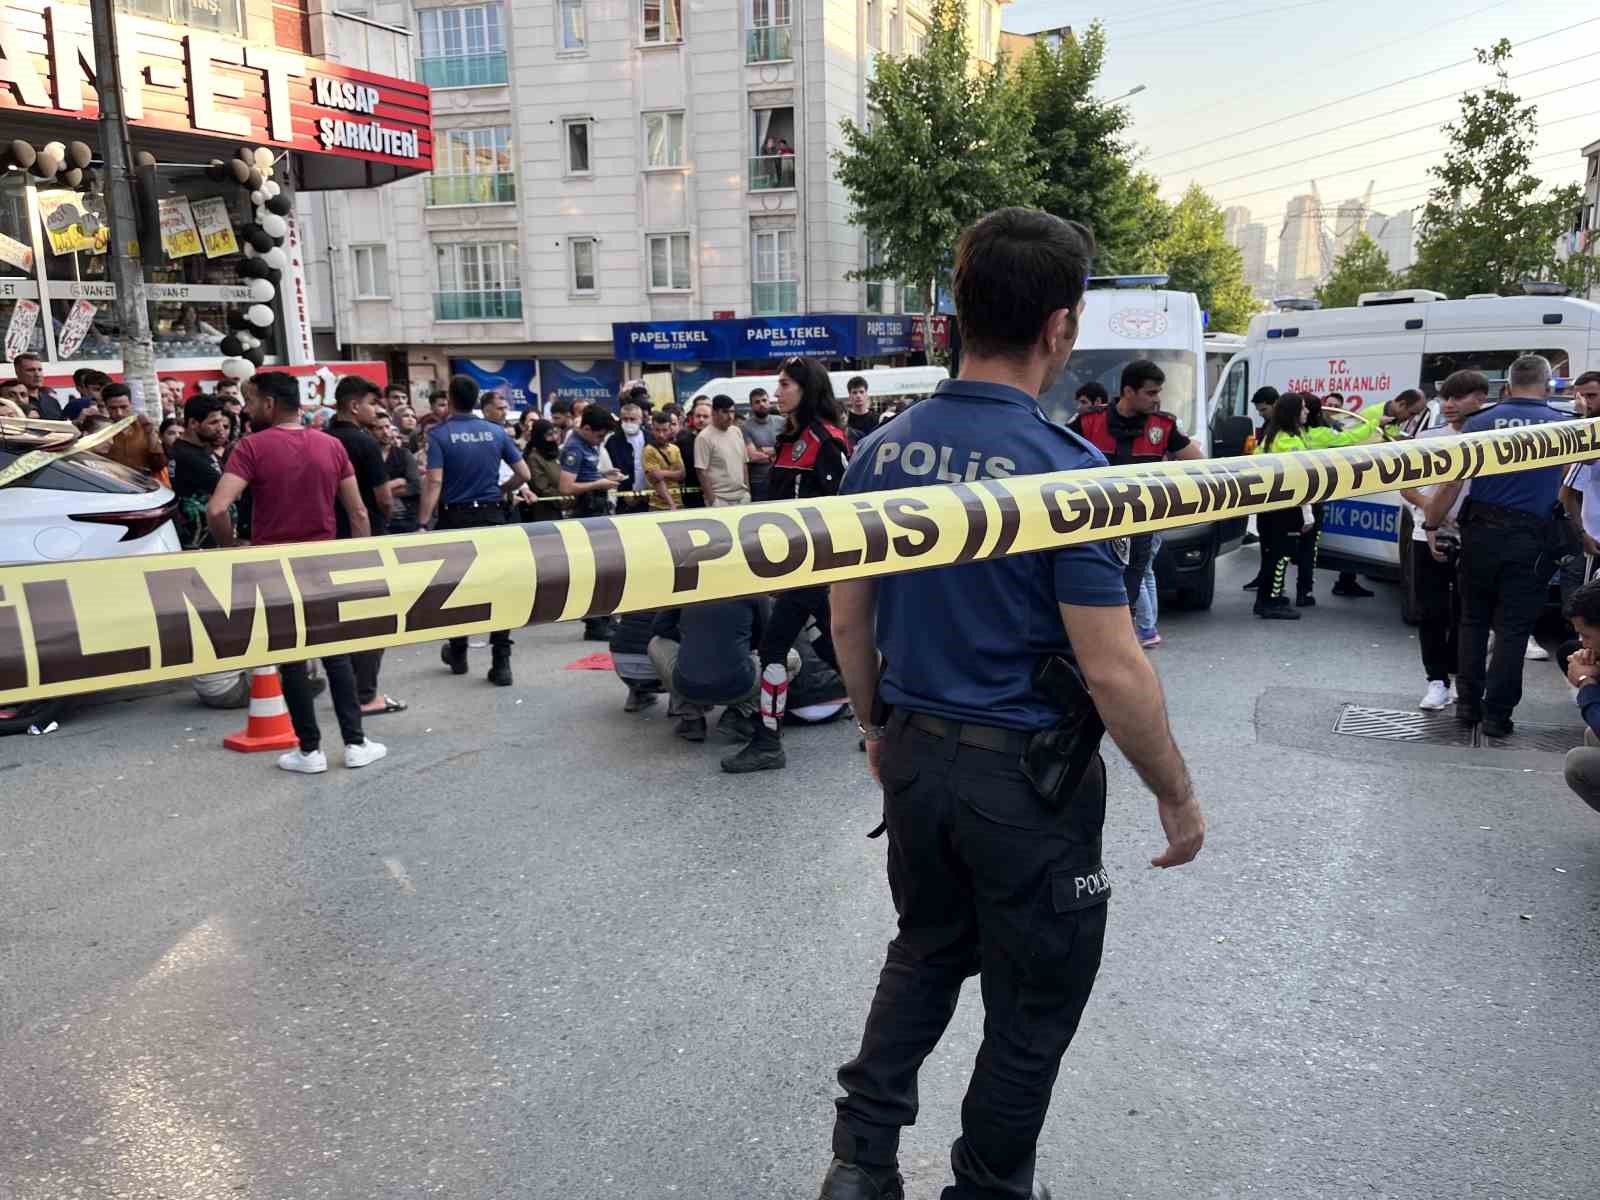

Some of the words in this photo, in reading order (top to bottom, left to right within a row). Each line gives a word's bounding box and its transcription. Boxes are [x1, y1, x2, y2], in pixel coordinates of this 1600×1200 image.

[314, 77, 379, 114] KASAP
[319, 117, 419, 158] ŞARKÜTERİ
[631, 331, 669, 343] PAPEL
[671, 330, 709, 342] TEKEL
[747, 327, 787, 340] PAPEL
[789, 326, 829, 338] TEKEL
[1328, 360, 1350, 375] T.C.
[1288, 375, 1325, 393] SAĞLIK
[1328, 371, 1391, 392] BAKANLIĞI
[557, 388, 583, 398] PAPEL
[584, 388, 611, 398] TEKEL
